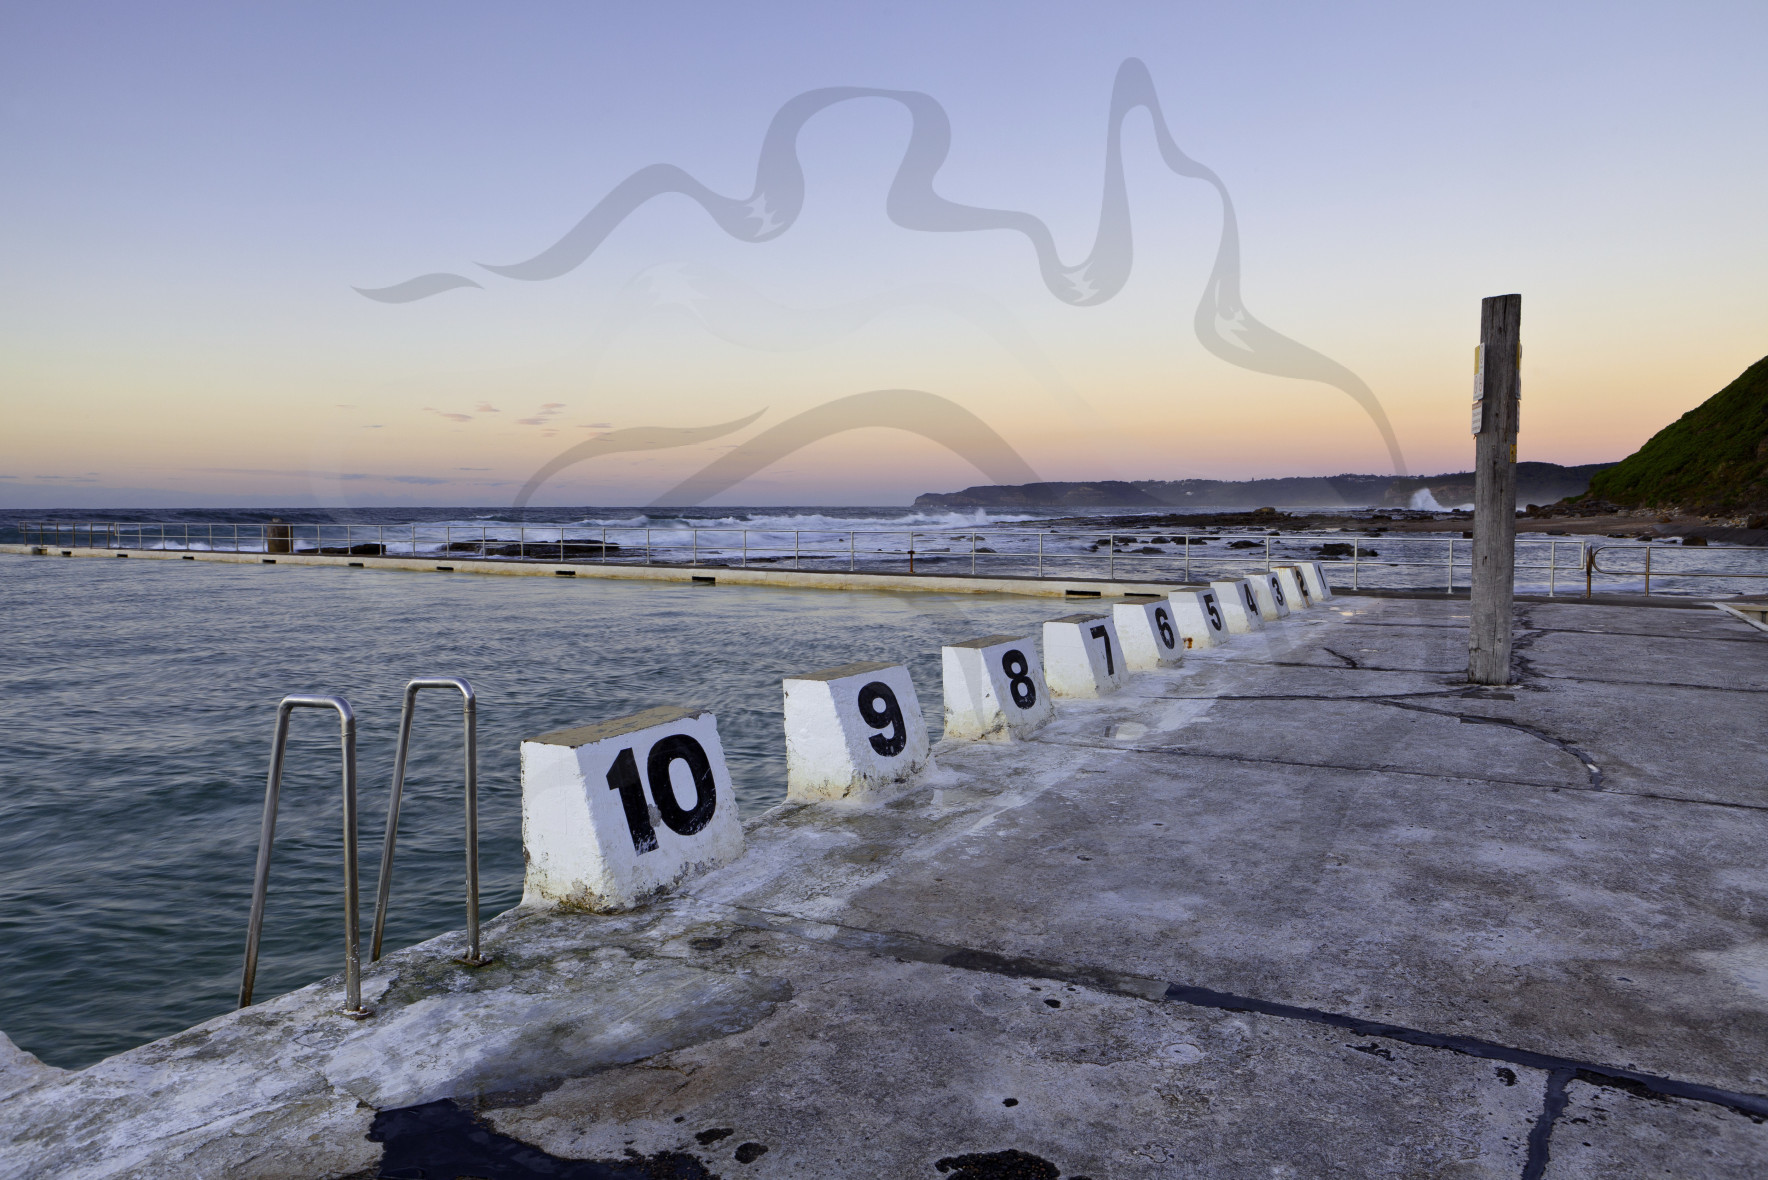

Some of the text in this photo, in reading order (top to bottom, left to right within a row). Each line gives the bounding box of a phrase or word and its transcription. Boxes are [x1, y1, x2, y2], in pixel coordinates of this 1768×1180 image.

[1271, 577, 1284, 606] 3
[1295, 570, 1308, 597] 2
[1317, 565, 1327, 590] 1
[1203, 593, 1222, 631] 5
[1243, 583, 1259, 616] 4
[1154, 607, 1175, 650] 6
[1090, 624, 1115, 676] 7
[1001, 649, 1037, 710] 8
[857, 681, 907, 757] 9
[606, 733, 717, 856] 10
